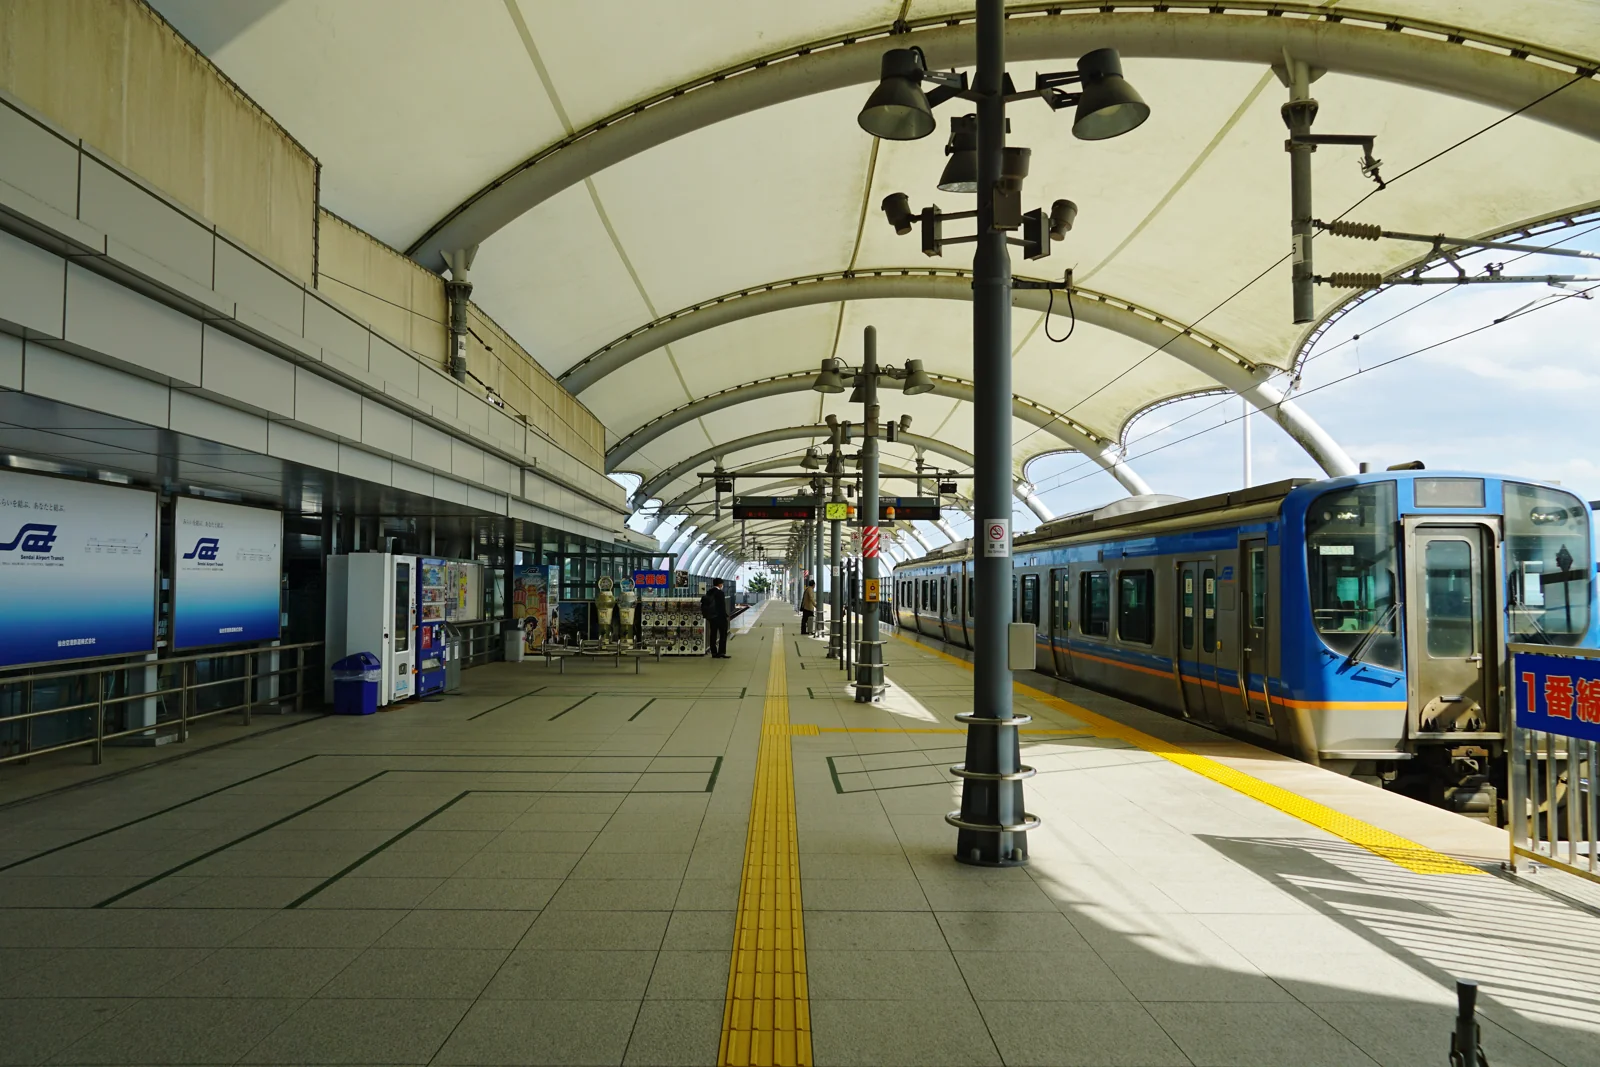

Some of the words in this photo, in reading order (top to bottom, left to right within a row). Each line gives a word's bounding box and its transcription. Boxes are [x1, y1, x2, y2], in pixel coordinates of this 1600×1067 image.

[736, 497, 741, 505] 2
[932, 498, 937, 506] 1
[1522, 672, 1600, 724] 1番線
